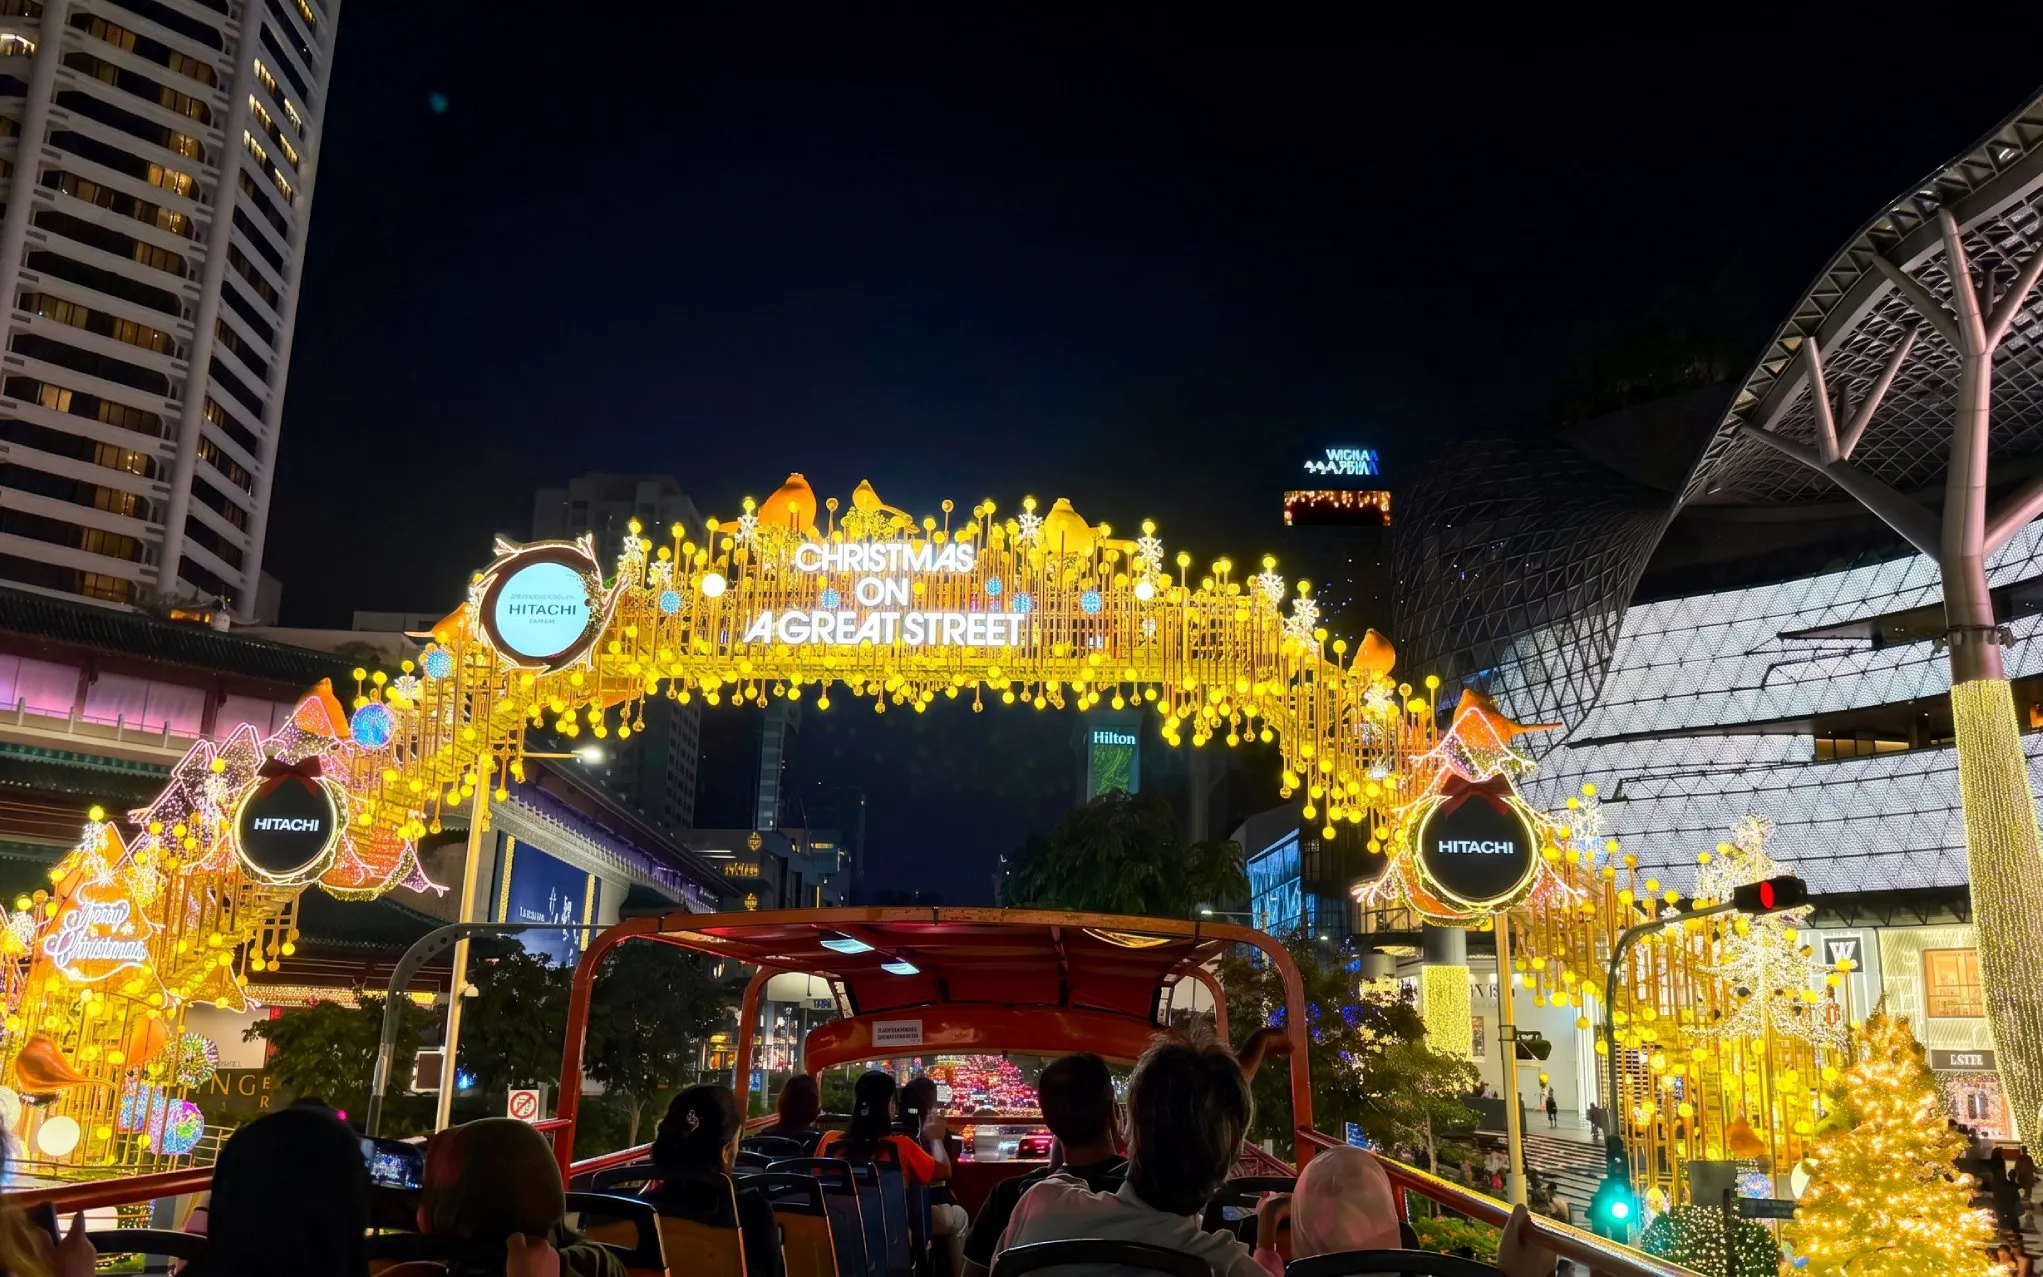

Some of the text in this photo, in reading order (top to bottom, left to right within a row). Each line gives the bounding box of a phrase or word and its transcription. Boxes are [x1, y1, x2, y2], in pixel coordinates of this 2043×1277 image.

[794, 543, 974, 573] CHRISTMAS
[856, 577, 909, 606] ON
[509, 604, 576, 615] HITACHI
[743, 611, 1025, 647] A GREAT STREET
[1094, 731, 1136, 745] Hilton
[254, 818, 319, 832] HITACHI
[1438, 840, 1514, 854] HITACHI
